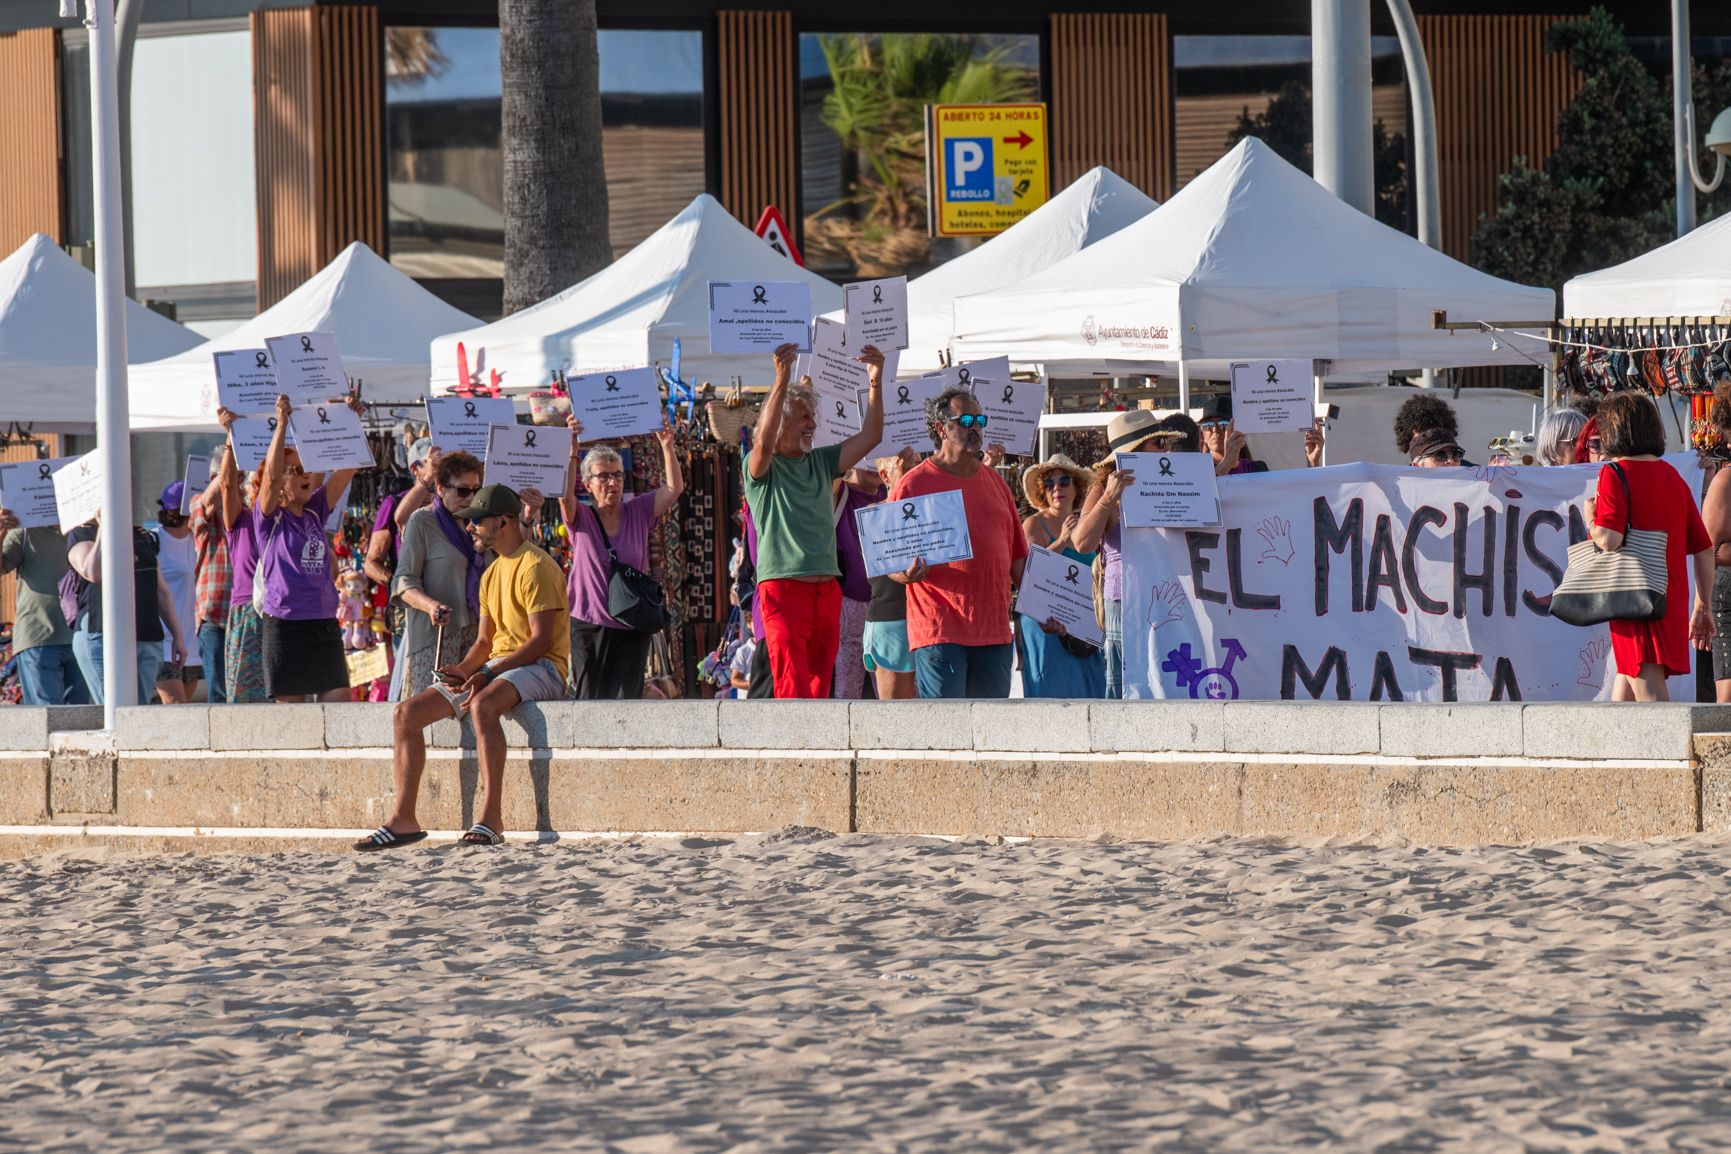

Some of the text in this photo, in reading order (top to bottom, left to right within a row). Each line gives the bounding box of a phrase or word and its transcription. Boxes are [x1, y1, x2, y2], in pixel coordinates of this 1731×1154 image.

[944, 110, 1039, 121] ABIERTO 24 HORAS
[954, 141, 984, 186] P
[950, 189, 990, 199] REBOLLO
[1098, 325, 1168, 340] Ayuntamiento de Cádiz
[1184, 528, 1281, 610] EL
[1034, 584, 1050, 593] Nombre
[1055, 593, 1074, 603] apellidos
[1280, 642, 1522, 702] MATA
